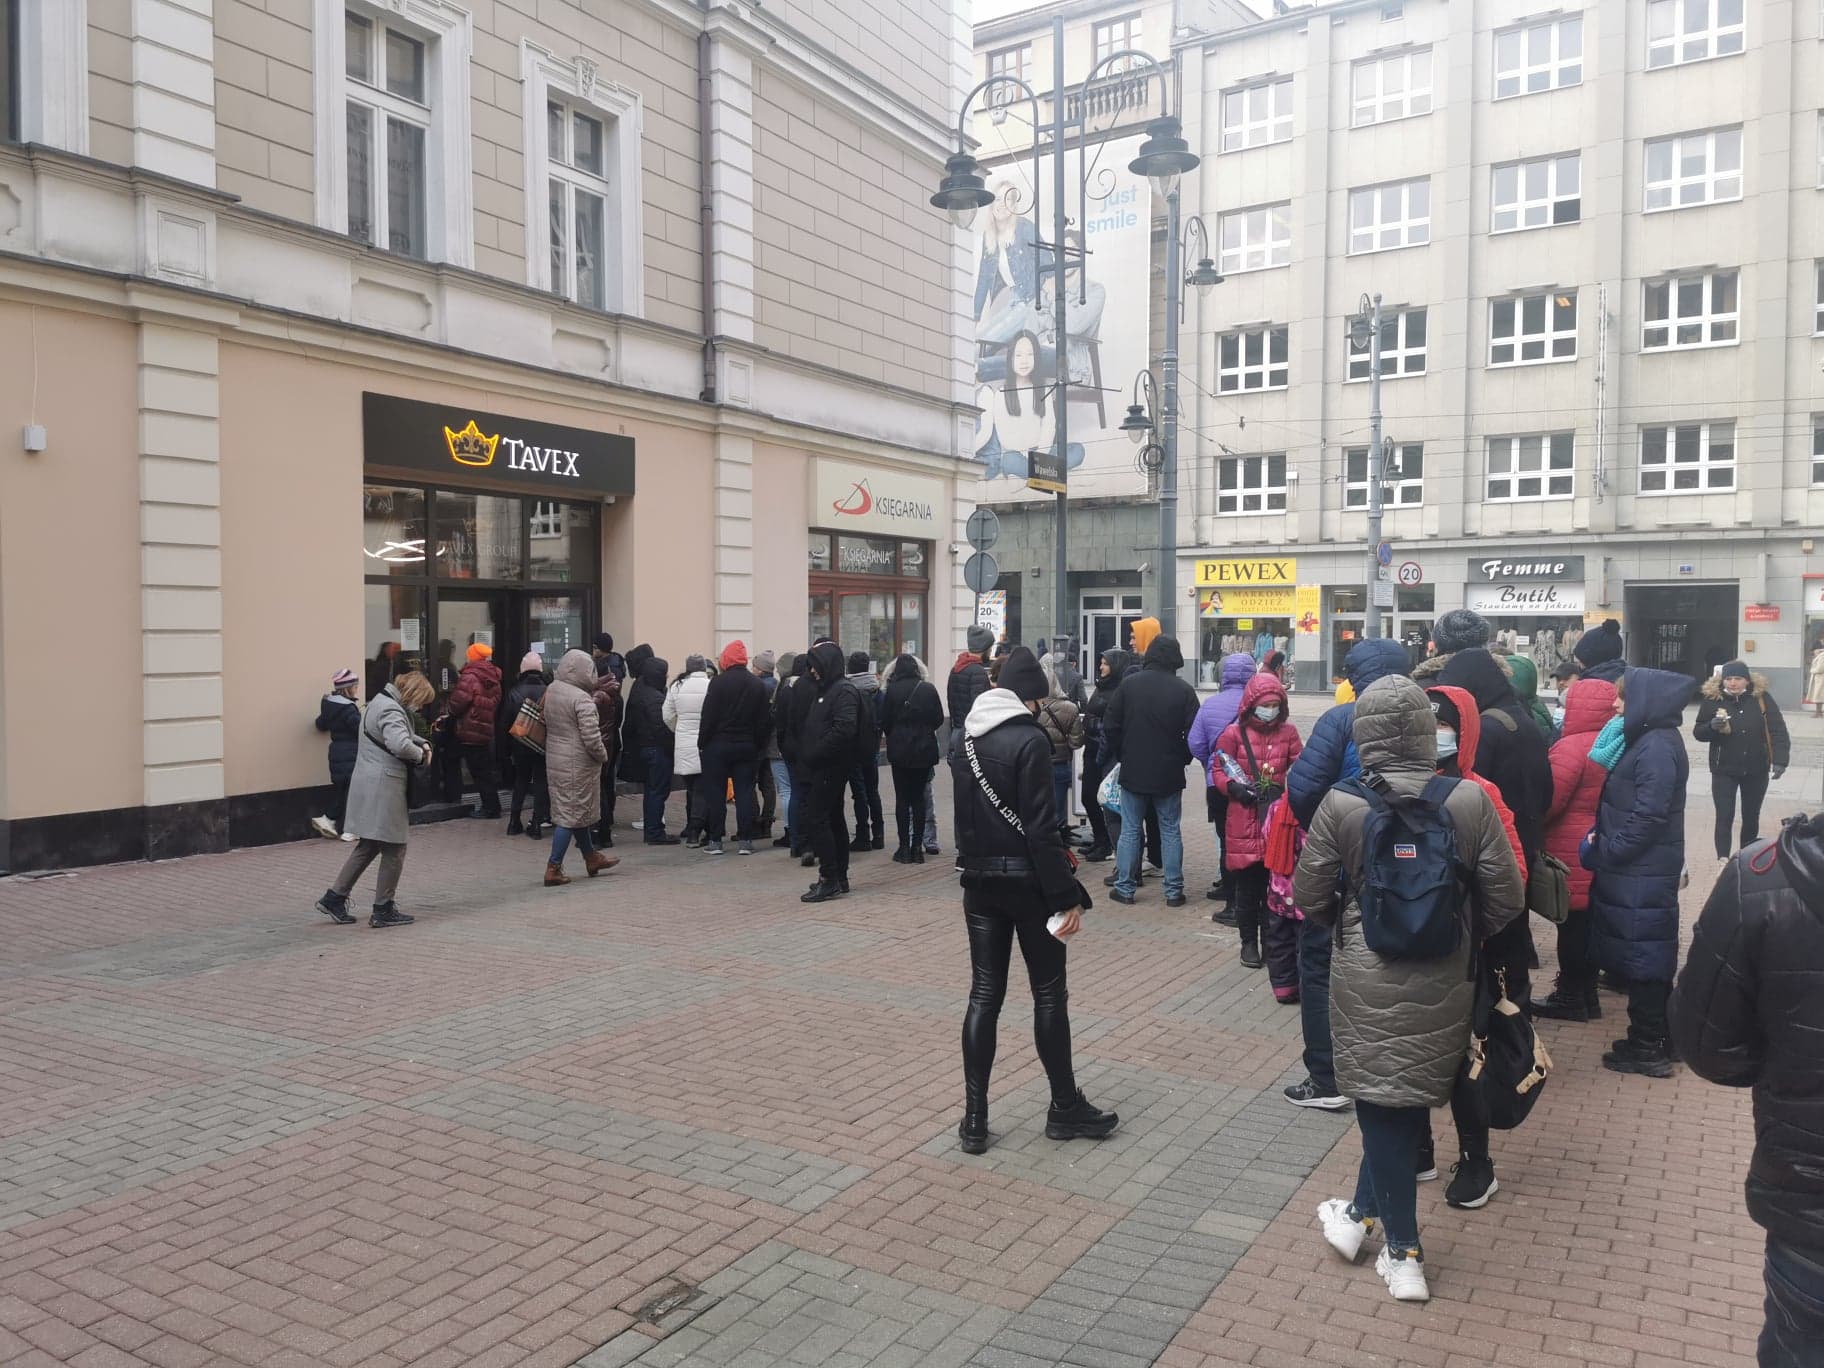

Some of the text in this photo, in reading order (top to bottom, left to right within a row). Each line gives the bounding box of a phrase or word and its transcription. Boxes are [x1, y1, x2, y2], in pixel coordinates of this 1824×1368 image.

[1100, 184, 1136, 213] just
[1087, 209, 1137, 233] smile
[502, 437, 580, 477] TAVEX
[875, 496, 932, 520] KSIĘGARNIA
[1203, 563, 1288, 581] PEWEX
[1403, 568, 1419, 580] 20
[1482, 560, 1565, 580] Femme
[1496, 585, 1557, 602] Butik
[965, 740, 1026, 836] OJECT YOUTH PROJECT
